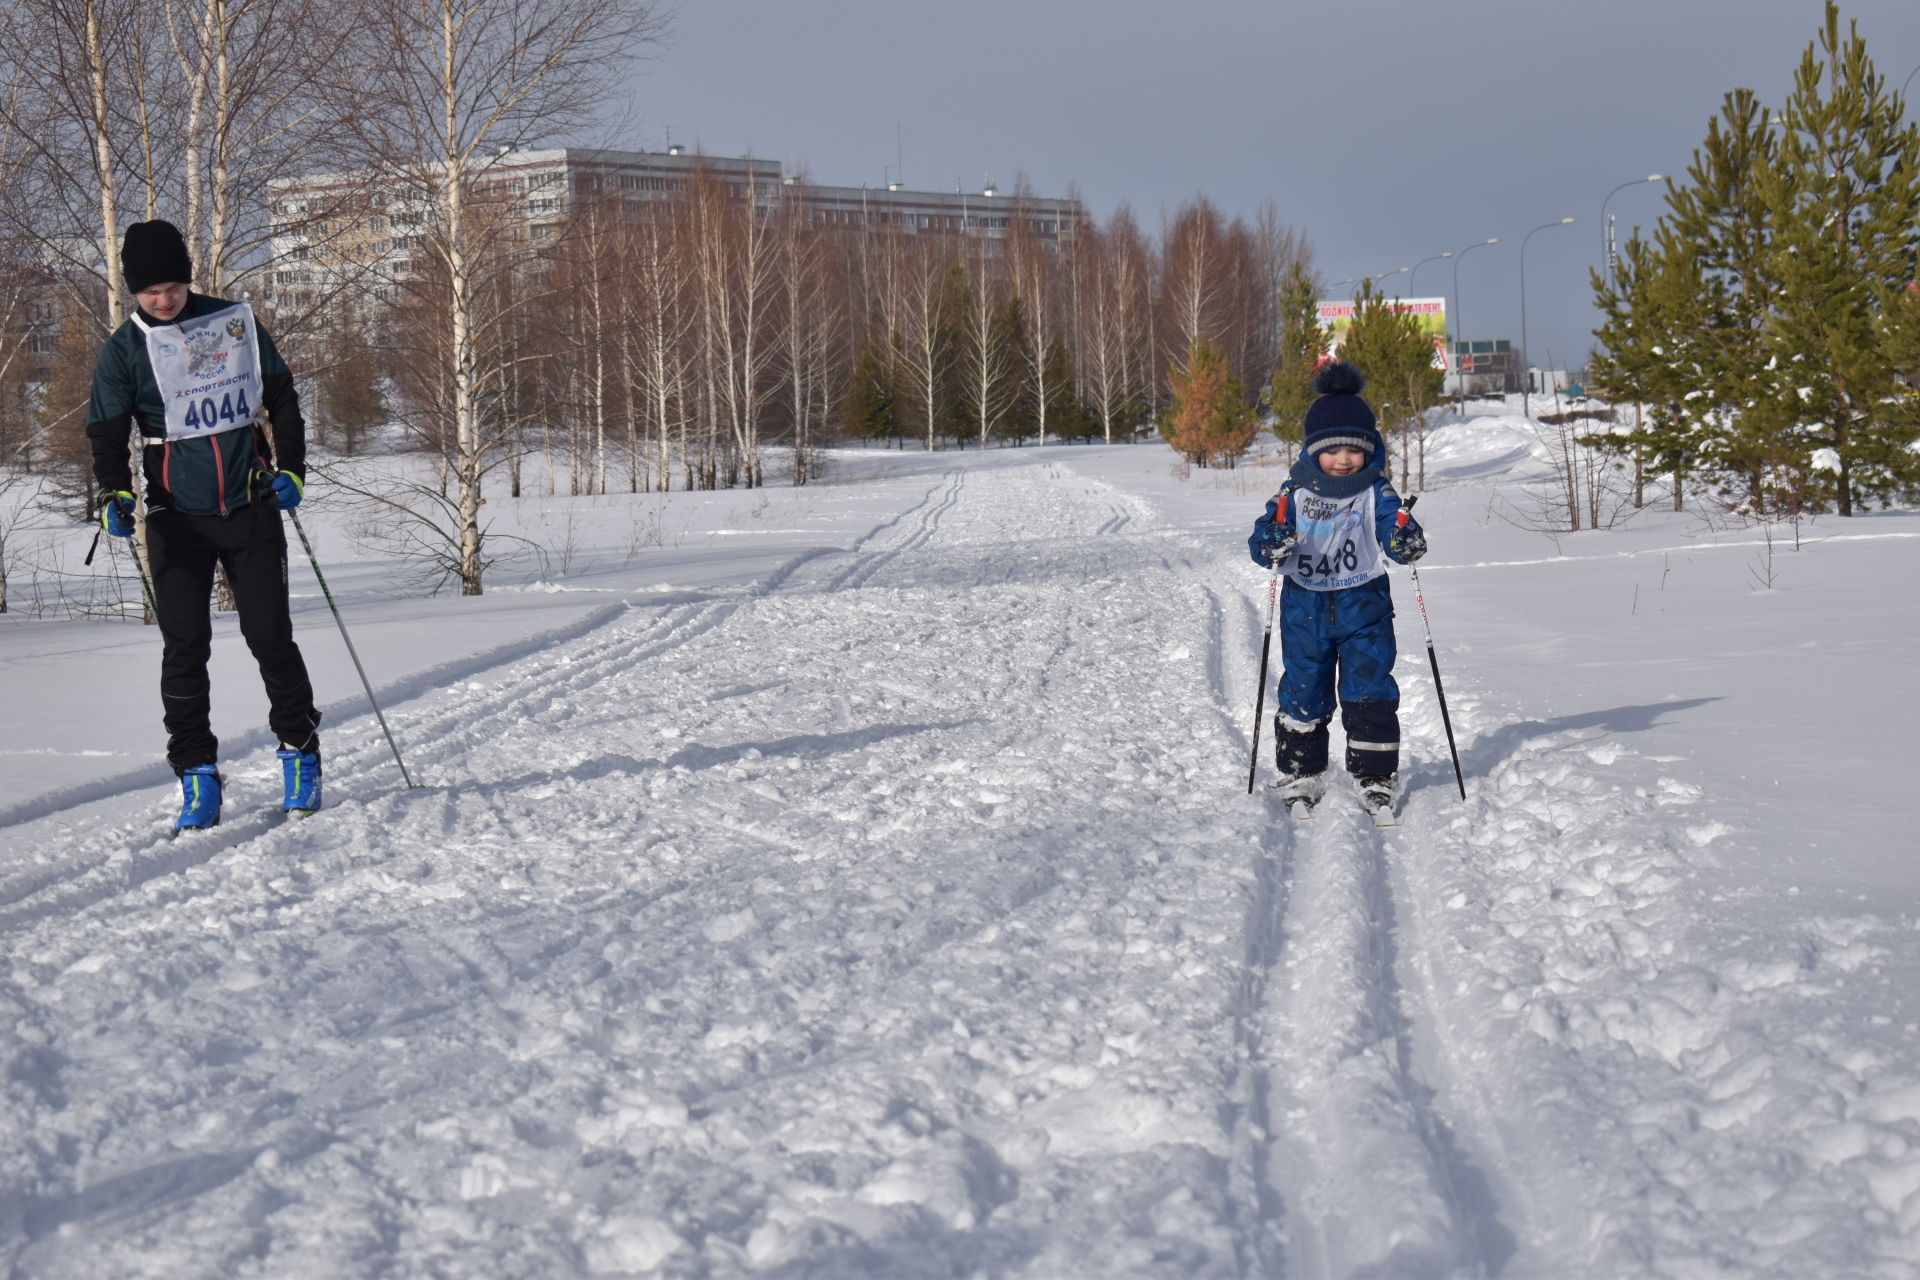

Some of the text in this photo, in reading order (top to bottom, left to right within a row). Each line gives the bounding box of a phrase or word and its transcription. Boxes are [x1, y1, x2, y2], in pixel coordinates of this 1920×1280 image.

[184, 330, 217, 346] ЛЫЖНЯ
[185, 388, 250, 430] 4044
[1330, 572, 1369, 588] Татарстан
